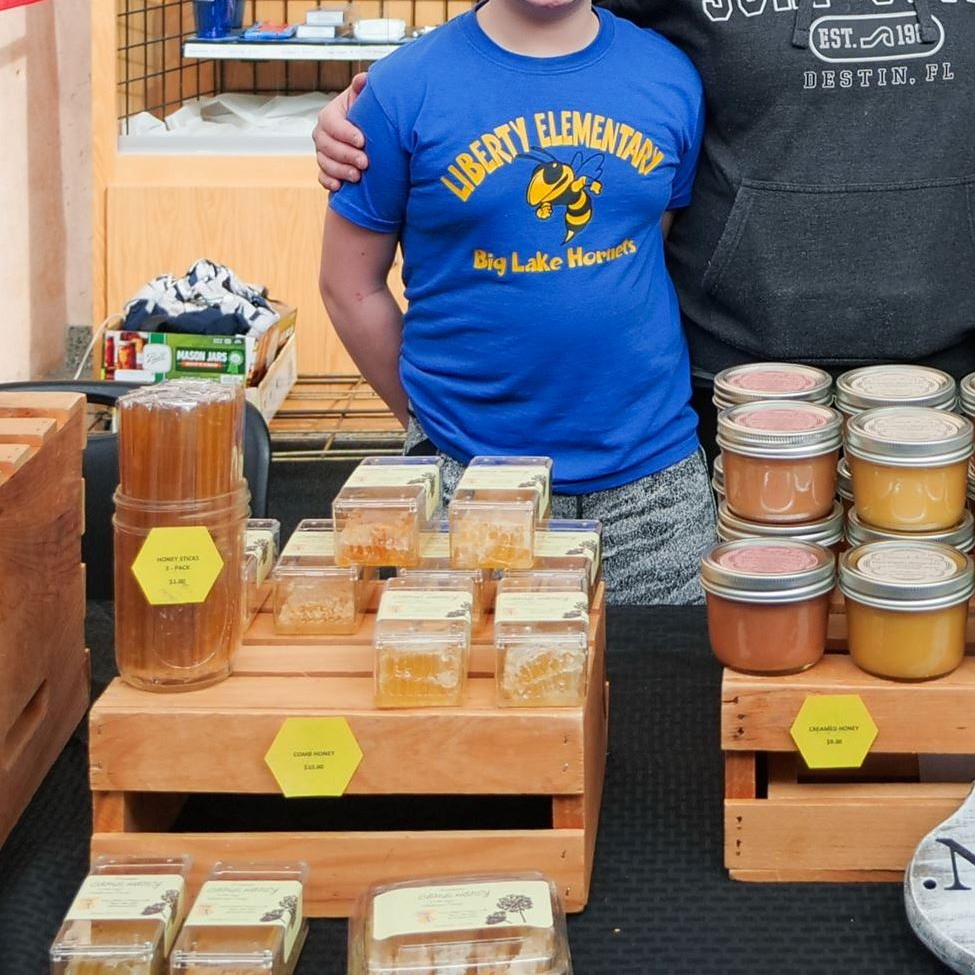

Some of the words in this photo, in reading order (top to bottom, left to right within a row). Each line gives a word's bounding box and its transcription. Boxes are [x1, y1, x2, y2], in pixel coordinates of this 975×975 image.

[818, 27, 857, 50] EST.
[926, 62, 955, 82] FL
[440, 116, 531, 203] LIBERTY
[534, 110, 665, 176] ELEMENTARY
[473, 248, 507, 277] Big
[511, 251, 564, 273] Lake
[567, 238, 637, 269] Hornets
[176, 350, 206, 361] MASON
[206, 352, 228, 363] JARS
